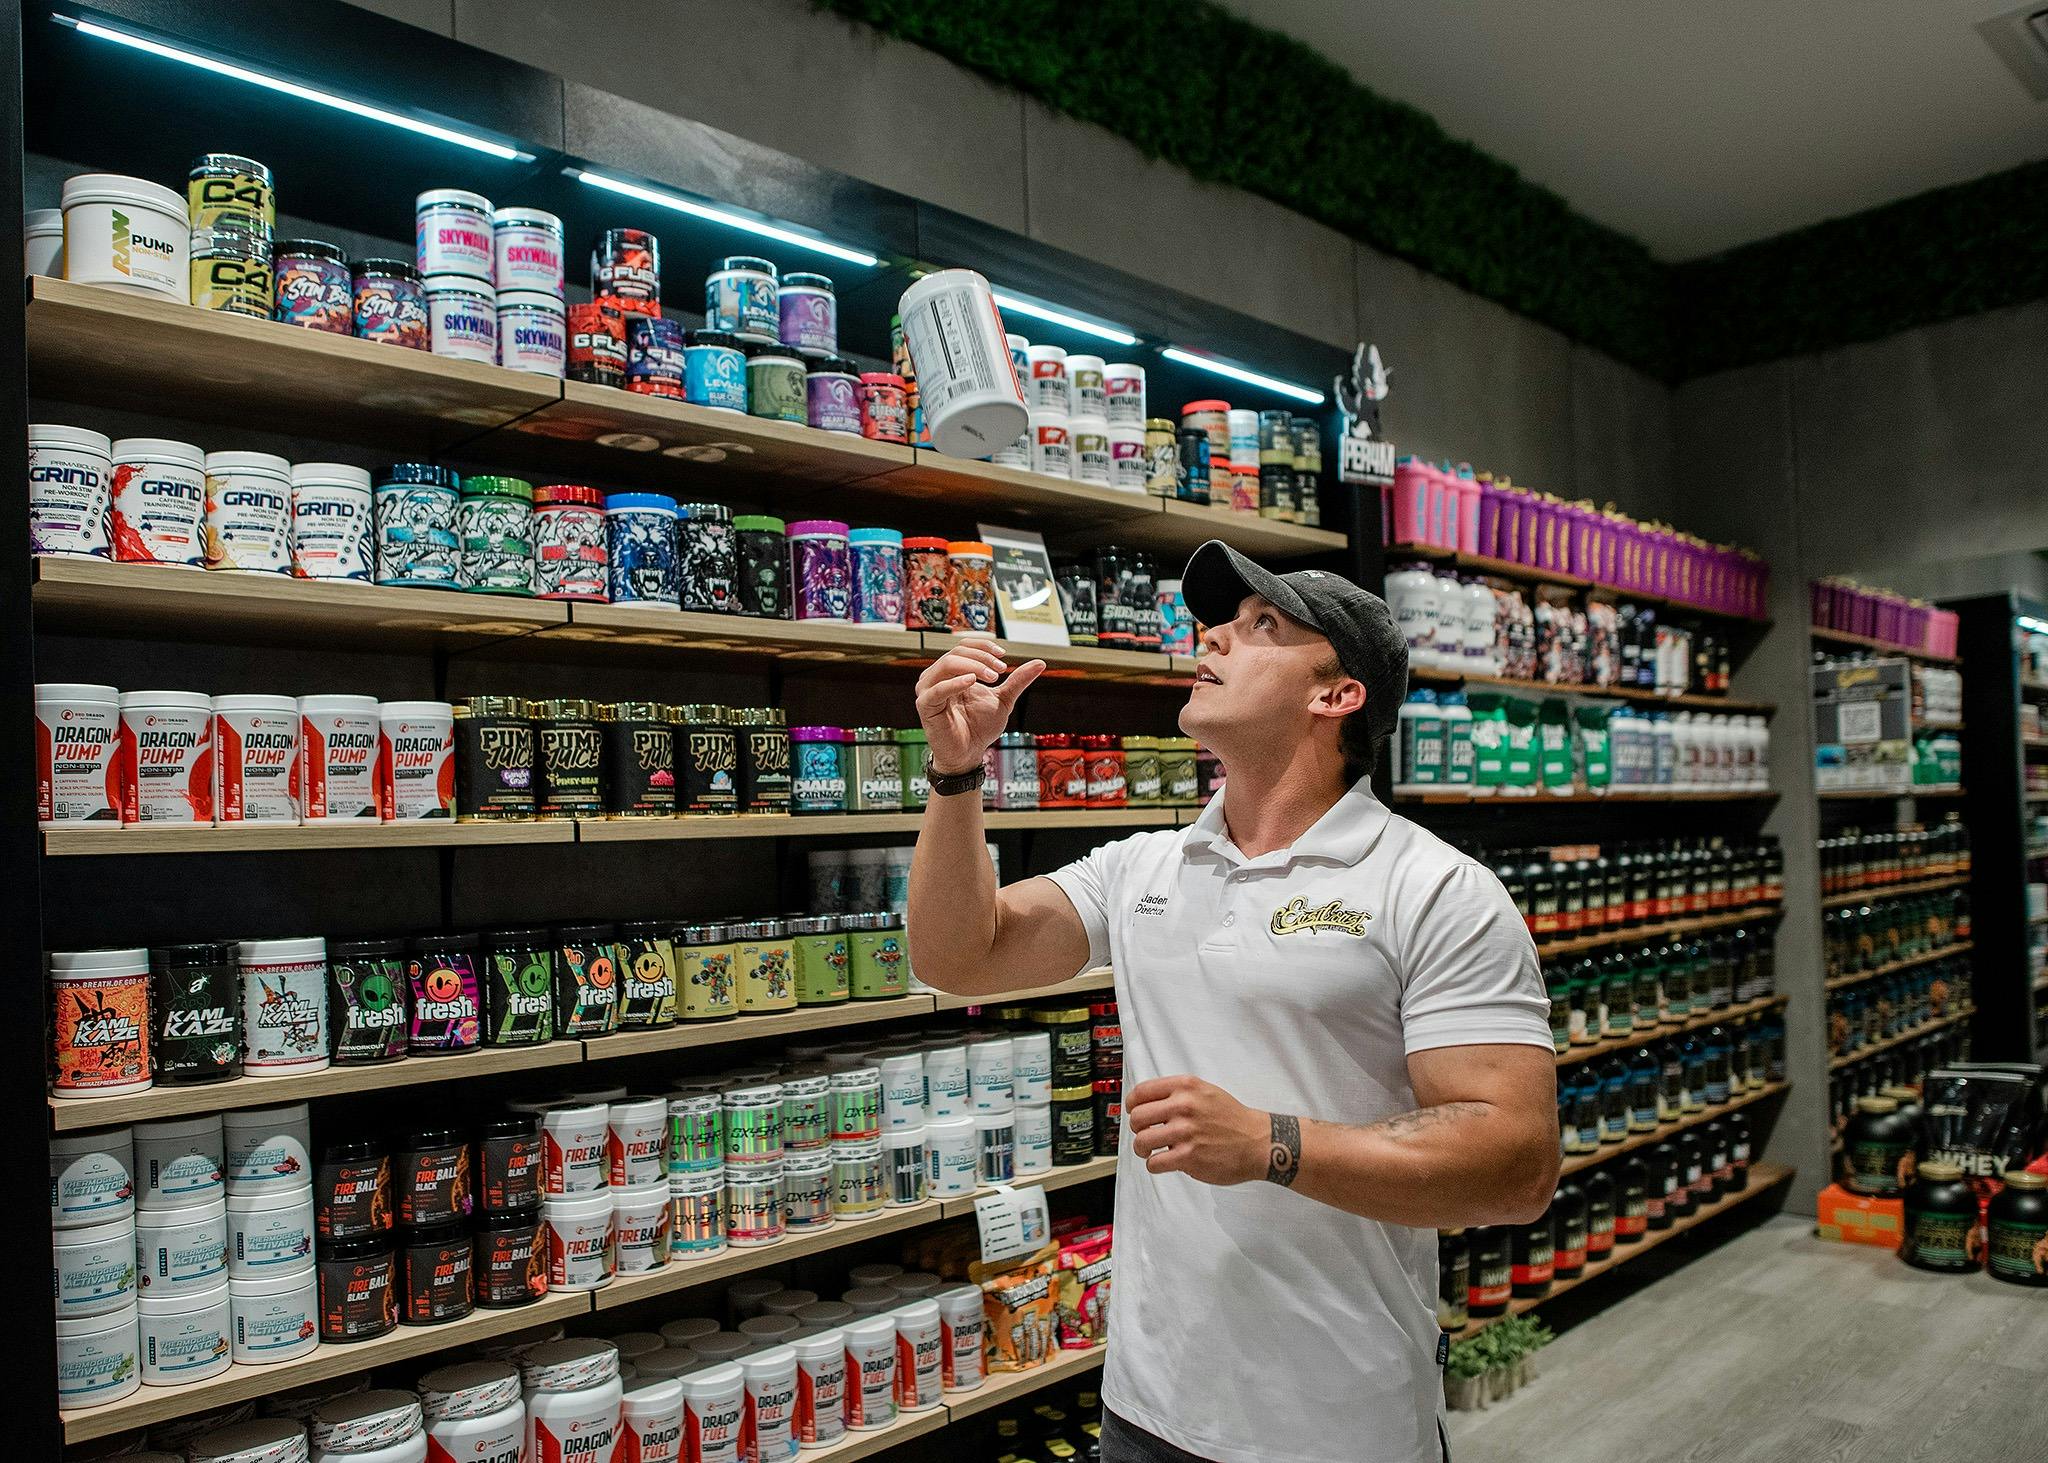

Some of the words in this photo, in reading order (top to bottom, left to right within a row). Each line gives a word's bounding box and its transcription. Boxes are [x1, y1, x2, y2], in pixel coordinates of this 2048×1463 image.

[202, 175, 264, 209] C4
[112, 208, 130, 277] RAW
[132, 234, 174, 255] PUMP
[211, 260, 270, 294] C4
[287, 277, 326, 301] STIM
[362, 294, 398, 318] STIM
[574, 333, 591, 348] G
[30, 467, 99, 488] GRIND
[44, 489, 91, 499] PRE-WORKOUT
[141, 480, 202, 502] GRIND
[224, 491, 285, 511] GRIND
[296, 502, 354, 517] GRIND
[409, 542, 450, 553] ULTIMATE
[484, 552, 525, 563] ULTIMATE
[562, 559, 600, 568] ULTIMATE
[54, 726, 112, 744] DRAGON
[139, 732, 196, 748] DRAGON
[245, 733, 294, 749] DRAGON
[328, 733, 375, 749] DRAGON
[541, 729, 602, 752] PUMP
[634, 731, 673, 752] PUM
[395, 738, 443, 752] DRAGON
[690, 734, 736, 755] PUM
[751, 733, 789, 754] PUM
[54, 744, 102, 760] PUMP
[139, 748, 185, 764] PUMP
[245, 749, 286, 764] PUMP
[328, 749, 367, 763] PUMP
[396, 753, 433, 767] PUMP
[546, 748, 599, 770] JUICE
[639, 750, 673, 769] JUIC
[793, 779, 847, 793] DIALED
[862, 780, 903, 794] DIALE
[797, 790, 843, 800] CARNAGE
[1140, 893, 1168, 906] Jaden
[1134, 903, 1165, 917] Director
[409, 964, 419, 976] 40
[502, 960, 512, 971] 40
[264, 1000, 310, 1013] KAMI
[415, 995, 477, 1020] fresh.
[167, 1007, 224, 1023] KAMI
[259, 1009, 319, 1025] KAZE
[78, 1017, 130, 1031] KAMI
[163, 1017, 235, 1037] KAZE
[74, 1026, 139, 1044] KAZE
[229, 1149, 286, 1163] THERMOGENIC
[231, 1156, 285, 1169] ACTIVATOR
[508, 1153, 543, 1169] FIREBALL
[1936, 1152, 2012, 1176] WHEY
[416, 1167, 458, 1183] FIREBALL
[507, 1167, 528, 1178] BLACK
[63, 1173, 126, 1189] THERMOGENIC
[333, 1179, 379, 1196] FIREBALL
[415, 1182, 437, 1191] BLACK
[62, 1180, 125, 1199] ACTIVATOR
[333, 1194, 357, 1204] BLACK
[247, 1228, 304, 1244] THERMOGENIC
[617, 1222, 666, 1243] FIREBALL
[248, 1236, 304, 1253] ACTIVATOR
[491, 1246, 533, 1263] FIREBALL
[63, 1263, 127, 1280] THERMOGENIC
[434, 1258, 470, 1278] FIREBALL
[491, 1261, 513, 1271] BLACK
[64, 1271, 126, 1290] ACTIVATOR
[347, 1274, 390, 1294] FIREBALL
[433, 1276, 455, 1286] BLACK
[346, 1291, 370, 1302] BLACK
[247, 1320, 304, 1337] ACTIVATOR
[248, 1312, 305, 1329] THERMOGENIC
[159, 1331, 219, 1349] THERMOGENIC
[953, 1335, 976, 1348] FUEL
[158, 1339, 219, 1358] ACTIVATOR
[916, 1352, 937, 1365] FUEL
[862, 1371, 886, 1385] FUEL
[757, 1390, 795, 1408] DRAGON
[815, 1385, 838, 1399] FUEL
[702, 1410, 740, 1429] DRAGON
[757, 1406, 784, 1420] FUEL
[642, 1425, 680, 1447] DRAGON
[702, 1426, 728, 1441] FUEL
[564, 1428, 612, 1456] DRAGON
[643, 1443, 669, 1459] FUEL
